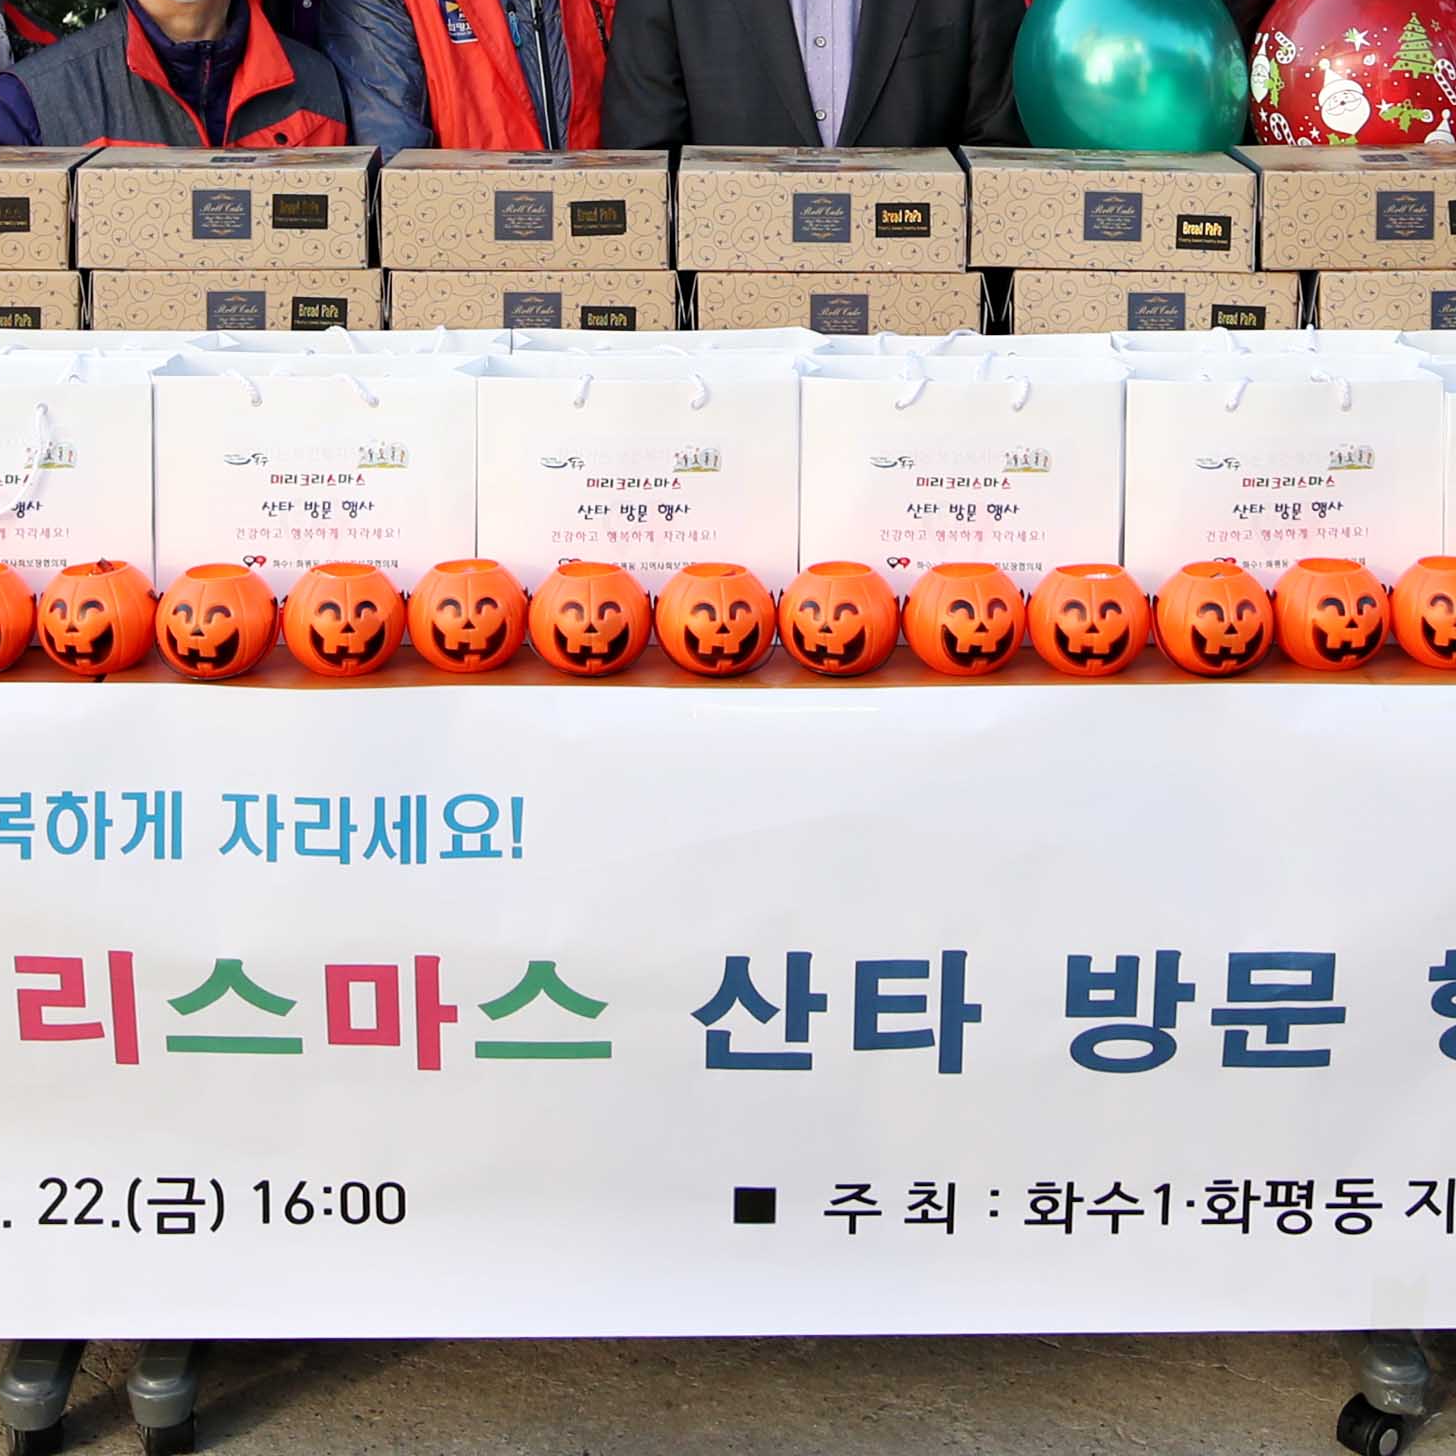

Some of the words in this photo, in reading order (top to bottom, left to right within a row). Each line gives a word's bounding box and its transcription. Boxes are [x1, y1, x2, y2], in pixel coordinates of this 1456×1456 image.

[1183, 221, 1203, 235] Bread
[299, 304, 319, 317] Bread
[588, 313, 608, 326] Bread
[1218, 311, 1237, 325] Bread
[271, 474, 365, 486] 미리크리스마스
[586, 478, 681, 490] 미리크리스마스
[916, 477, 1011, 489] 미리크리스마스
[1243, 476, 1335, 489] 미리크리스마스
[262, 501, 294, 517] 산타
[304, 501, 332, 519] 방문
[342, 501, 374, 518] 행사
[578, 505, 611, 520] 산타
[620, 505, 647, 522] 방문
[658, 504, 691, 521] 행사
[907, 504, 939, 519] 산타
[949, 504, 976, 522] 방문
[987, 504, 1020, 521] 행사
[1233, 503, 1264, 519] 산타
[1275, 503, 1302, 520] 방문
[1312, 502, 1344, 518] 행사
[16, 528, 70, 539] 자라세요!
[236, 528, 282, 539] 건강하고
[291, 528, 338, 539] 행복하게
[347, 528, 401, 539] 자라세요!
[552, 531, 599, 542] 건강하고
[607, 531, 655, 542] 행복하게
[664, 530, 717, 542] 자라세요!
[880, 530, 927, 541] 건강하고
[936, 530, 983, 542] 행복하게
[993, 529, 1046, 541] 자라세요!
[1206, 530, 1252, 542] 건강하고
[1261, 528, 1308, 541] 행복하게
[1317, 527, 1369, 539] 자라세요!
[219, 794, 523, 865] 자라세요!
[690, 950, 982, 1074] 산타
[1065, 950, 1346, 1073] 방문
[38, 1177, 224, 1234] 22.(금)
[253, 1180, 406, 1225] 16:00
[1024, 1178, 1383, 1235] 화수1·화평동
